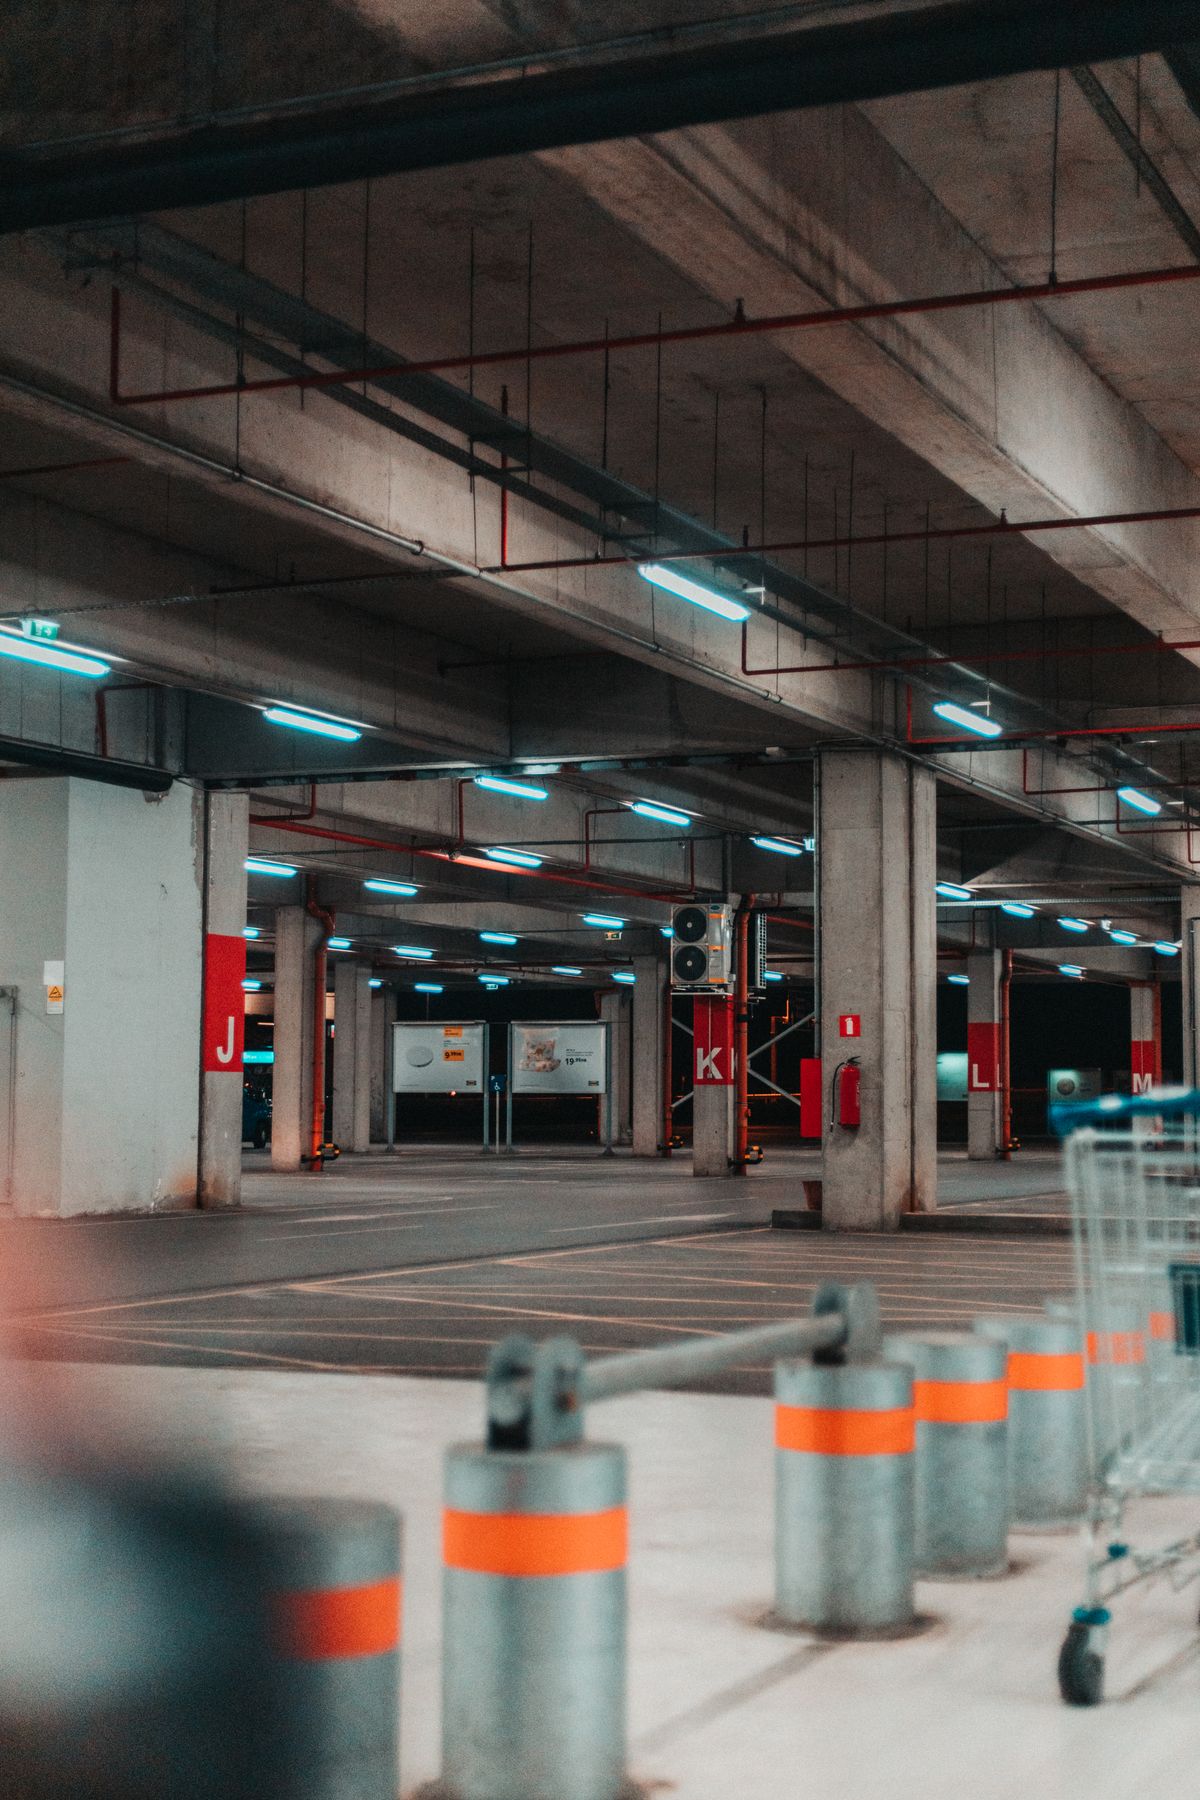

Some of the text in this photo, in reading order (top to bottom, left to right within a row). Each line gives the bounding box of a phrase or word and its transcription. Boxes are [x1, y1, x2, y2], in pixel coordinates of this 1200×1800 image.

[216, 1015, 235, 1064] J
[696, 1047, 724, 1080] K
[972, 1063, 990, 1088] L
[1133, 1072, 1153, 1093] M
